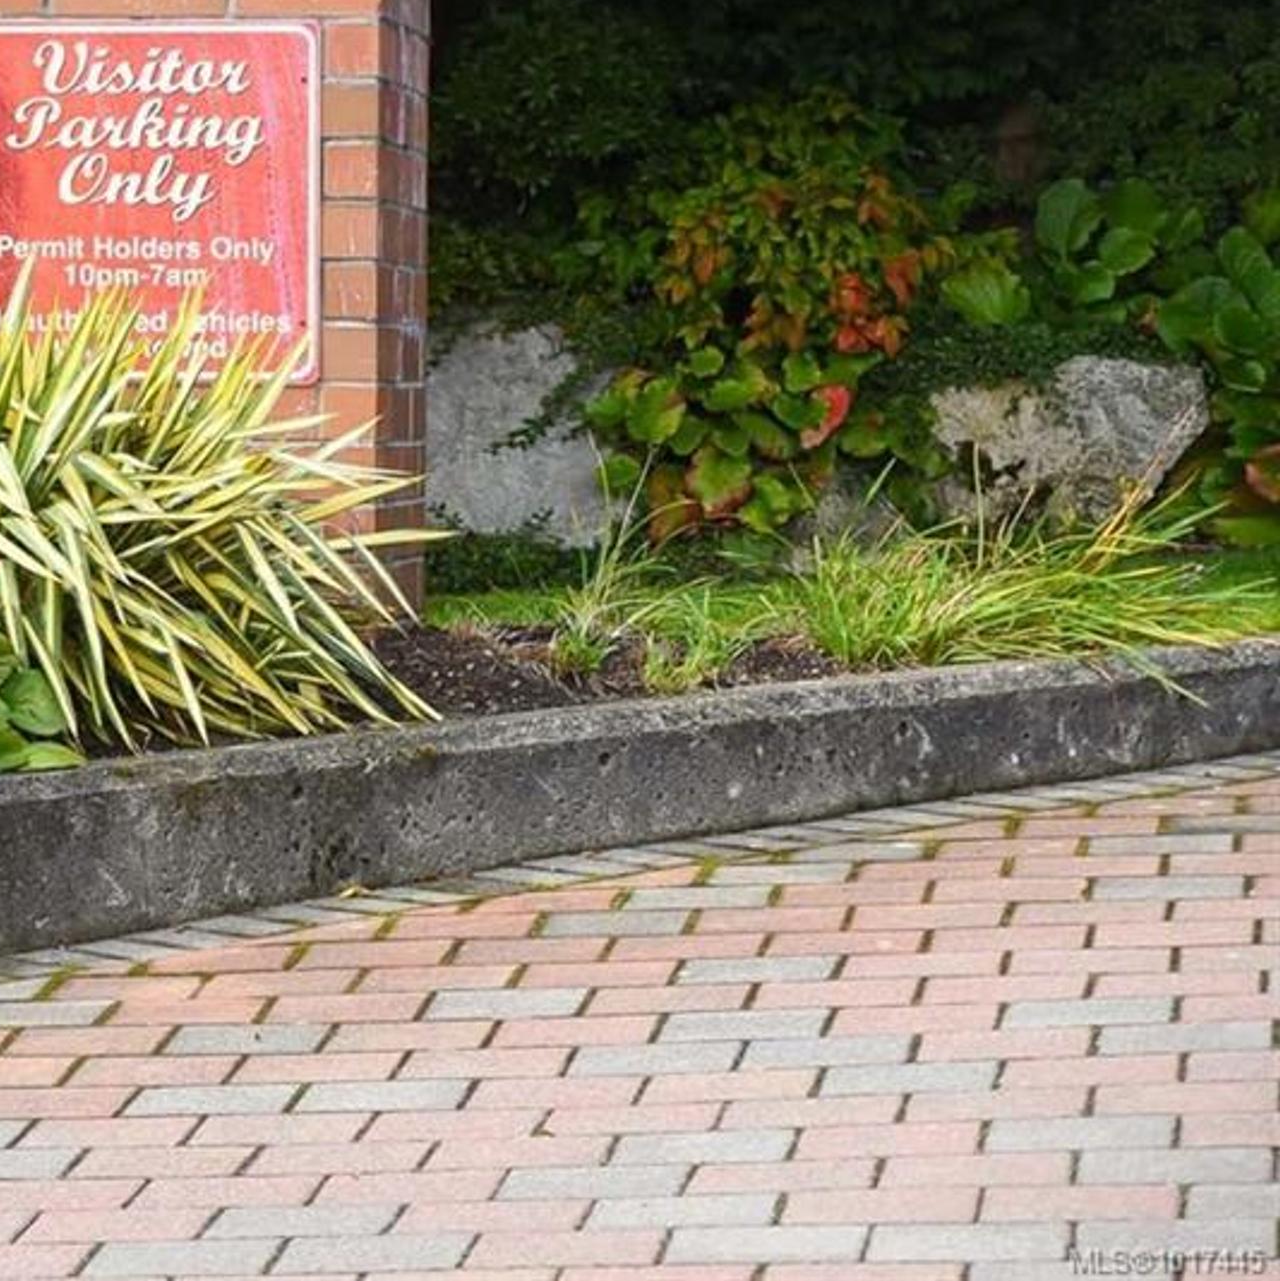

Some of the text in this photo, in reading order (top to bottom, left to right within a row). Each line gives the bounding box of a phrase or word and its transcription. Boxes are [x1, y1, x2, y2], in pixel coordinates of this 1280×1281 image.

[32, 39, 252, 95] Visitor
[5, 95, 266, 164] Parking
[57, 152, 217, 221] Only
[93, 235, 201, 259] Holders
[209, 235, 275, 265] Only
[64, 263, 209, 289] 10pm-7am
[186, 308, 292, 334] ehicles
